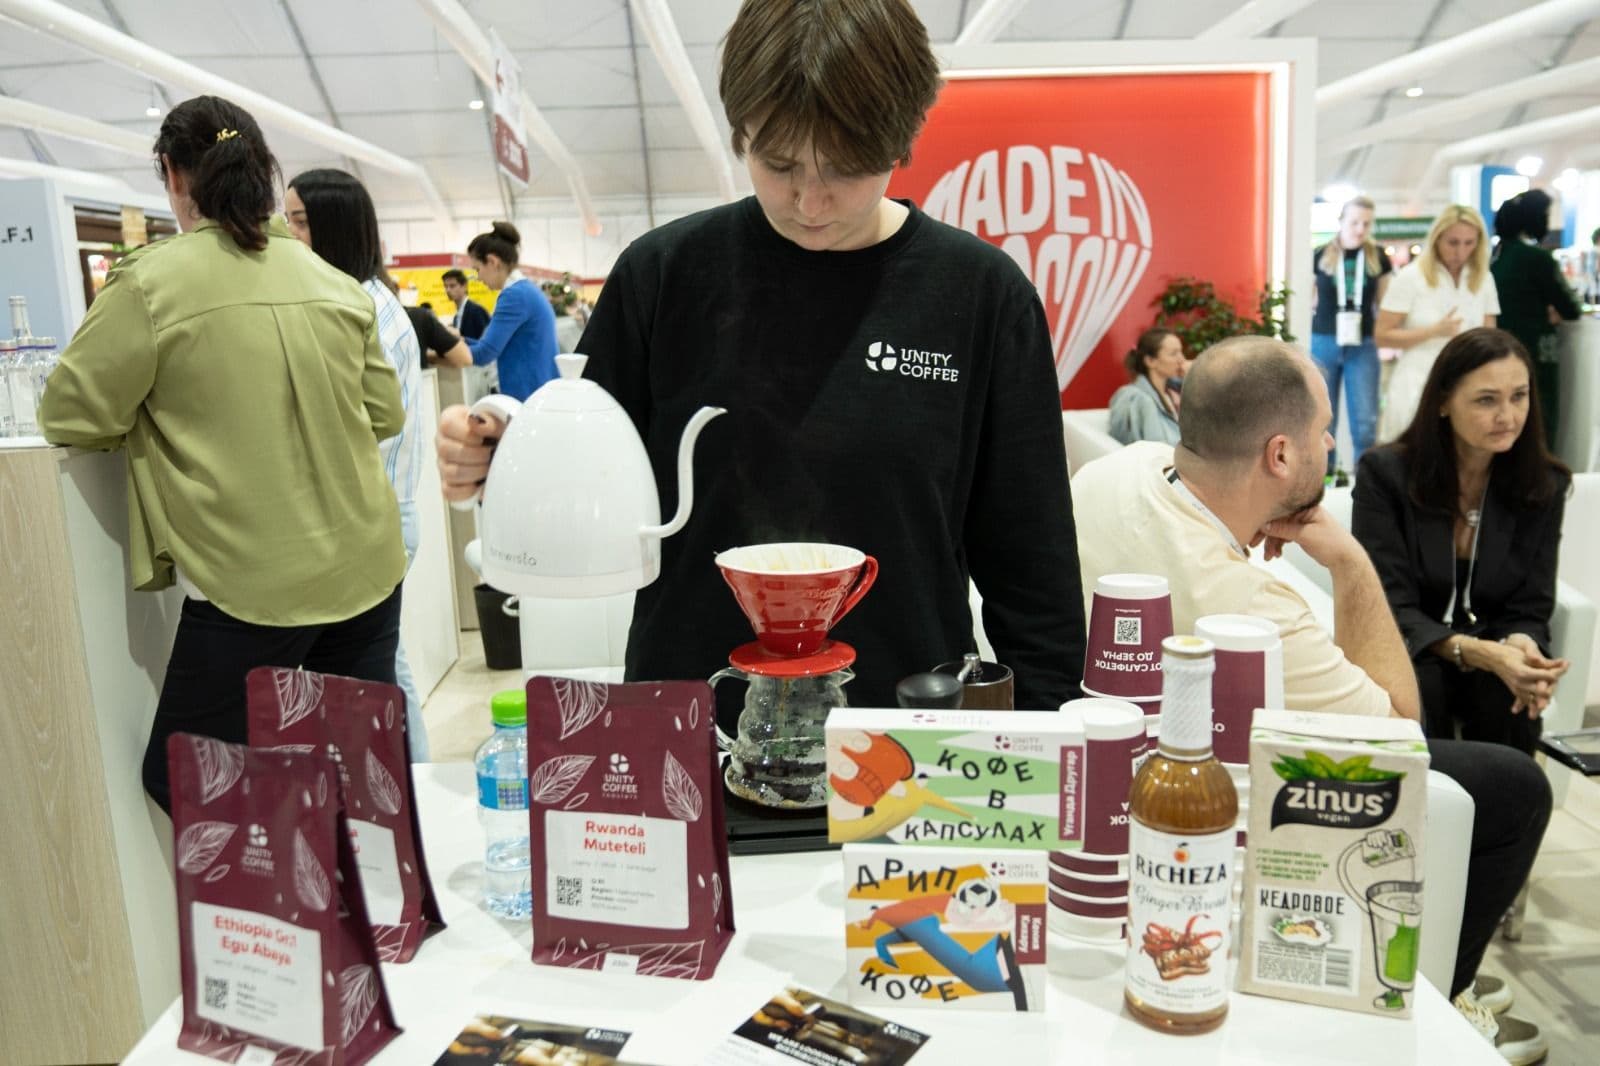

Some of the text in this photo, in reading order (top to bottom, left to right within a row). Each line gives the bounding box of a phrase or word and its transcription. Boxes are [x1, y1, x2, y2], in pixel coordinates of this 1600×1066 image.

[921, 145, 1152, 250] MADE IN
[900, 348, 952, 367] UNITY
[899, 362, 959, 382] COFFEE
[1103, 650, 1154, 661] ДО ЗЕРНА
[936, 749, 1034, 783] КОФЕ
[602, 782, 638, 793] COFFEE
[604, 773, 635, 784] UNITY
[987, 789, 1007, 810] В
[1286, 781, 1384, 817] zinus
[585, 820, 645, 837] Rwanda
[1317, 812, 1351, 823] vegan
[904, 819, 1045, 844] КАПСУЛАХ
[584, 837, 646, 855] Muteteli
[856, 858, 957, 892] ДРИП
[1260, 888, 1345, 915] КЕДРОВОЕ
[213, 914, 273, 939] Ethiopia
[221, 935, 292, 966] Egu Abaya
[860, 967, 960, 1003] КОФЕ
